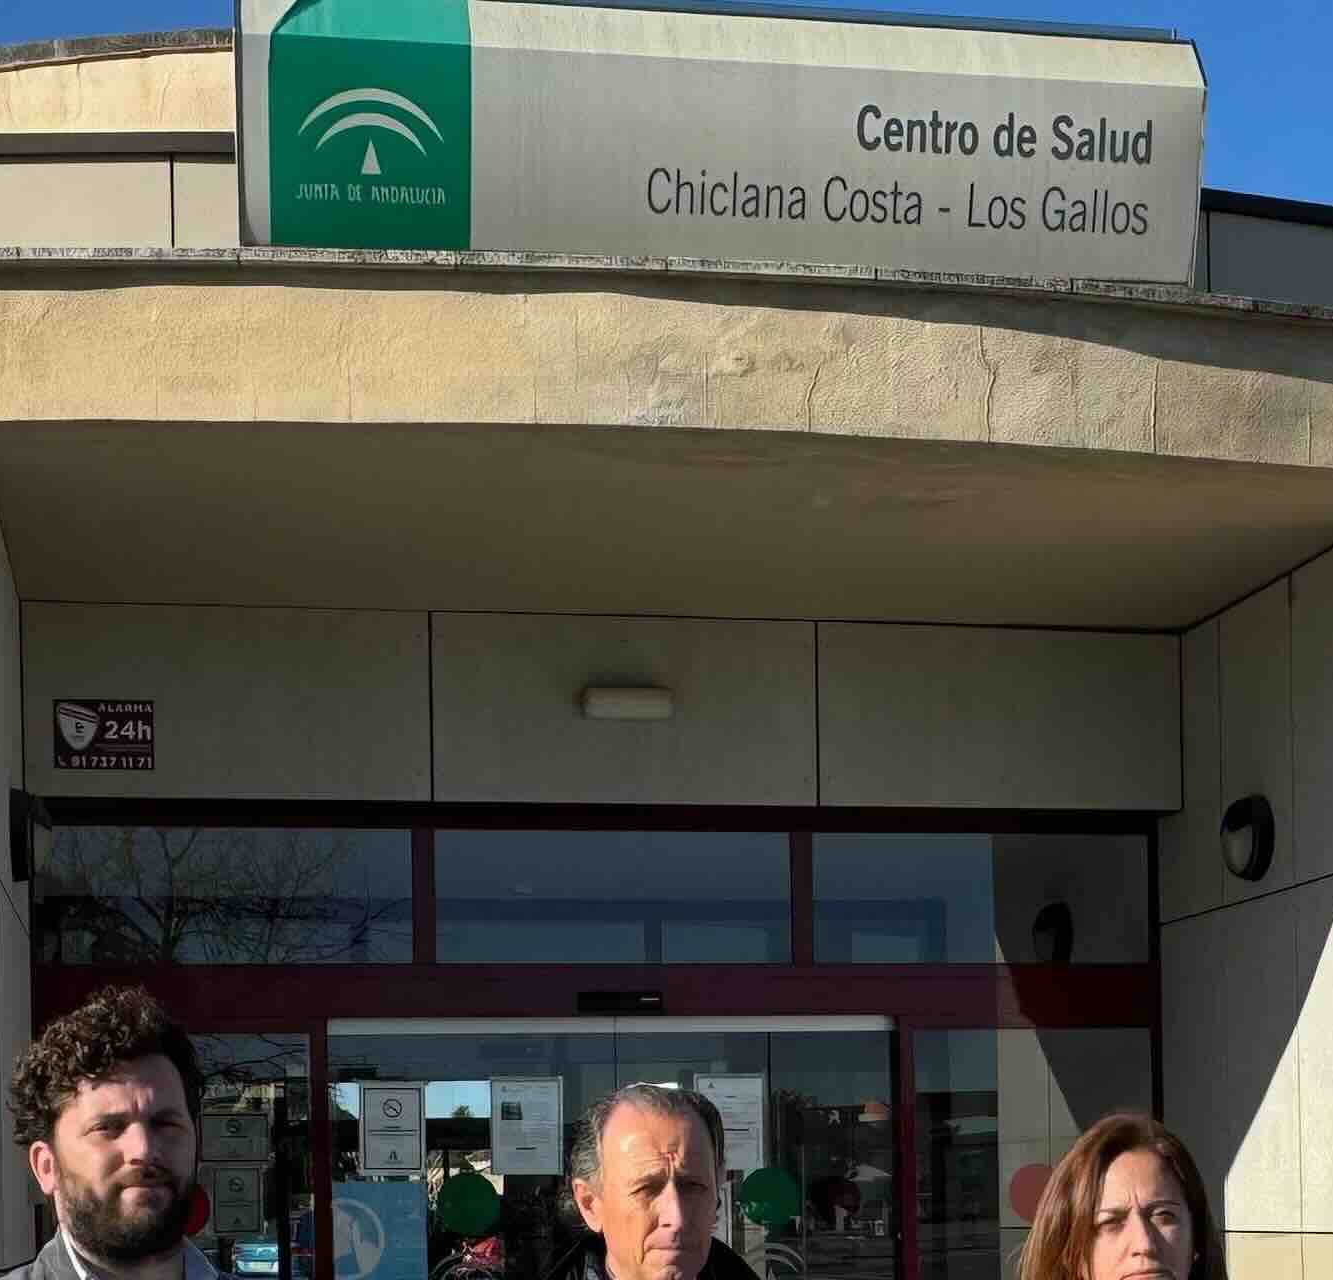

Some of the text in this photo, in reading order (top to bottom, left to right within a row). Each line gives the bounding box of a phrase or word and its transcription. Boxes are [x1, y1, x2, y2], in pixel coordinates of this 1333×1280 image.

[856, 103, 1154, 165] Centro de Salud
[295, 182, 341, 202] JUNTA
[347, 184, 364, 202] DE
[646, 166, 1149, 236] Chiclana Costa - Los Gallos
[97, 702, 154, 713] ALARMA
[104, 719, 152, 741] 24h
